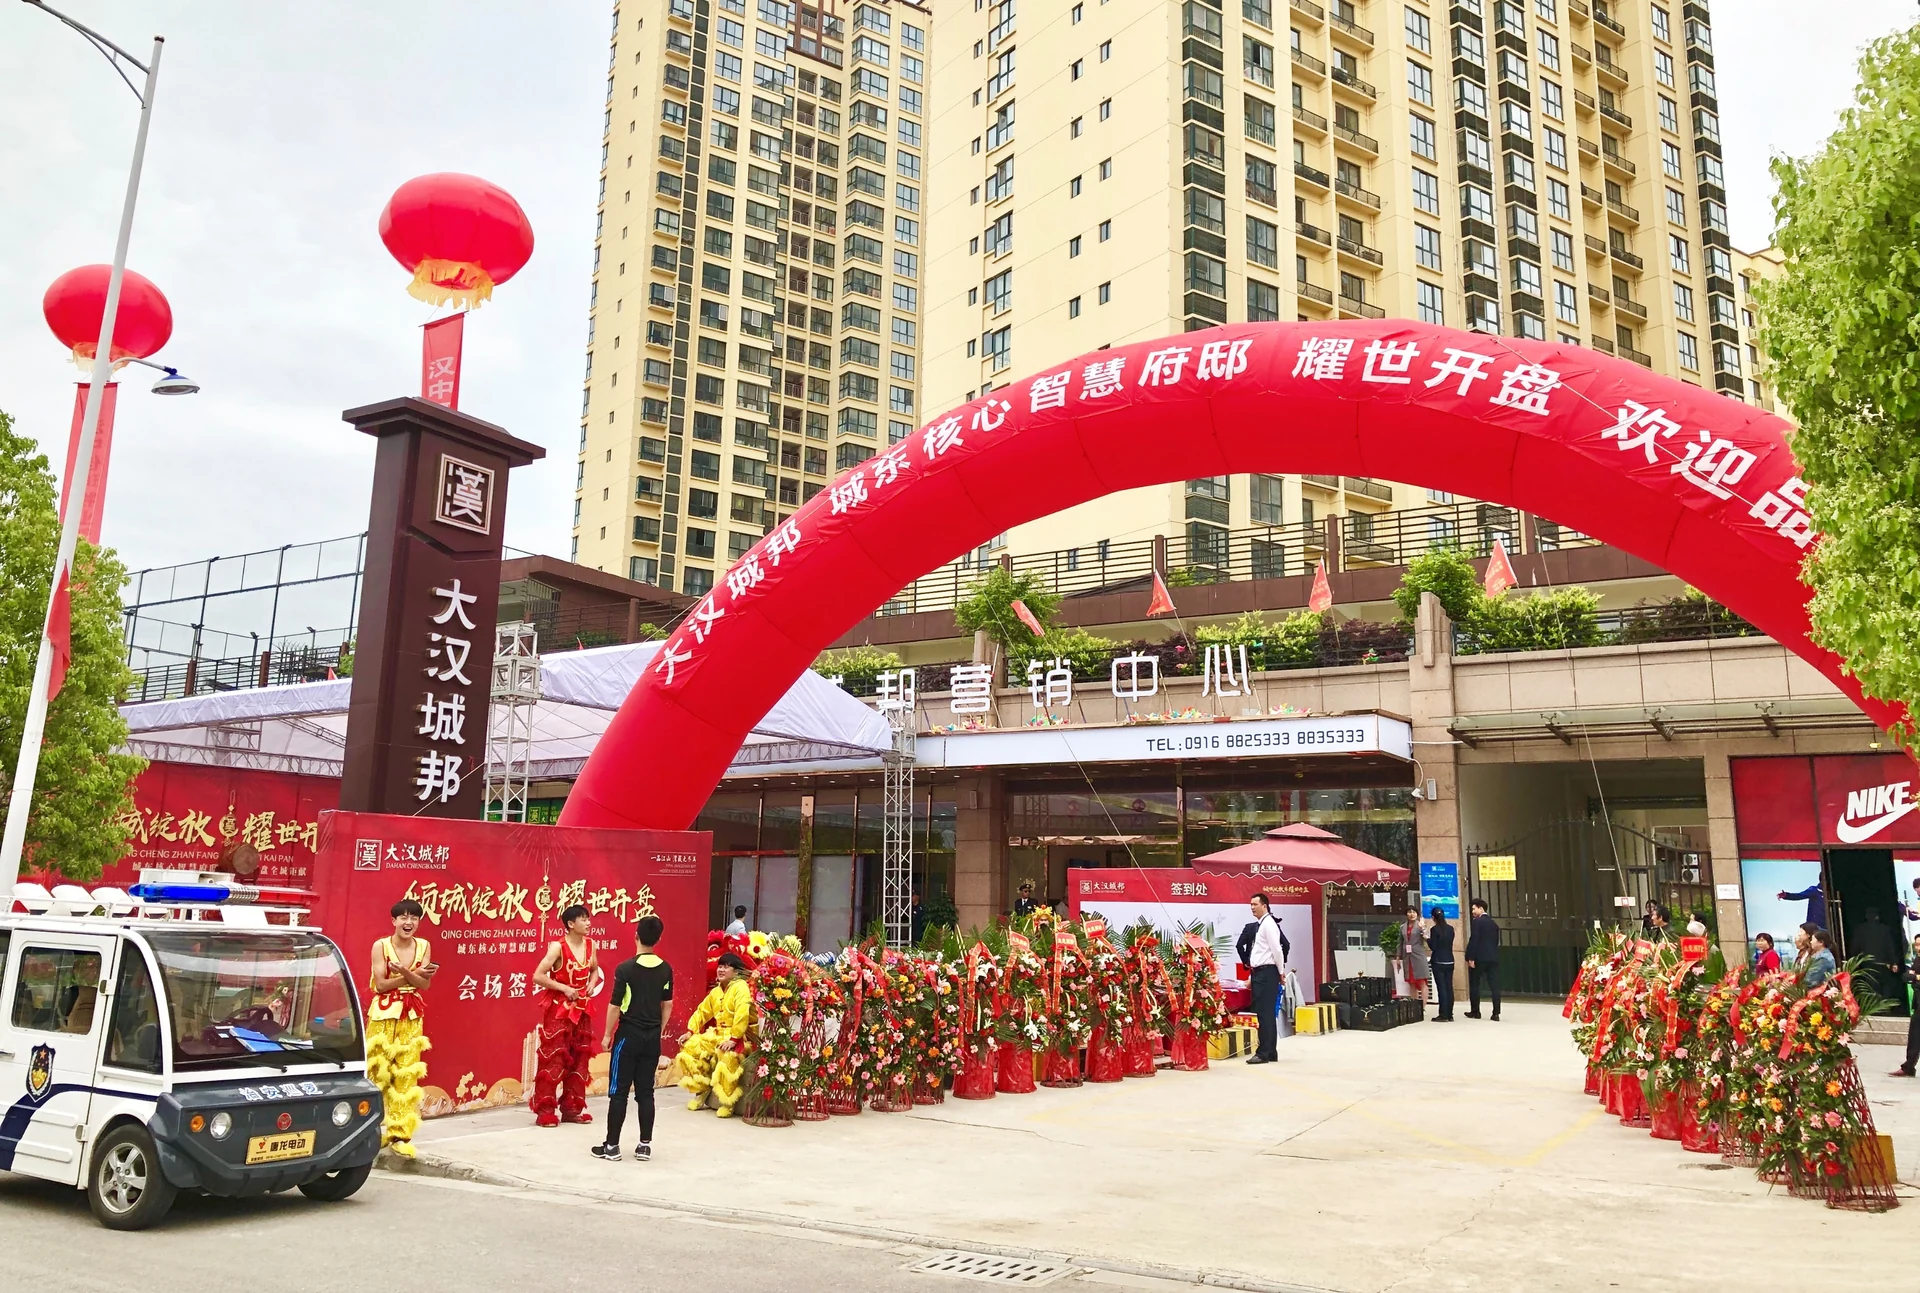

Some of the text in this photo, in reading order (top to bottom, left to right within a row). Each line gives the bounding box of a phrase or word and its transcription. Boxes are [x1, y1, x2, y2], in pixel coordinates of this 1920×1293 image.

[428, 356, 455, 409] 汉中
[654, 519, 802, 685] 大汉城邦
[830, 339, 1254, 516] 城东核心智慧府邸
[1291, 337, 1563, 417] 耀世开盘
[419, 578, 478, 803] 大汉城邦
[832, 643, 1252, 714] 邦营销中心
[1226, 732, 1290, 748] 8825333
[1297, 729, 1365, 745] 8835333
[1846, 781, 1911, 820] NIKE
[139, 849, 170, 859] CHENG
[171, 850, 195, 860] ZHAN
[196, 851, 220, 860] FANG
[263, 854, 278, 862] KAI
[278, 854, 294, 863] PAN
[384, 843, 450, 863] 大汉城邦
[1170, 882, 1208, 897] 签到处
[441, 929, 462, 939] QING
[463, 928, 492, 939] CHENG
[492, 928, 515, 938] ZHAN
[515, 927, 537, 938] FANG
[548, 928, 564, 937] YAO
[590, 927, 606, 937] PAN
[457, 972, 548, 1001] 会场签
